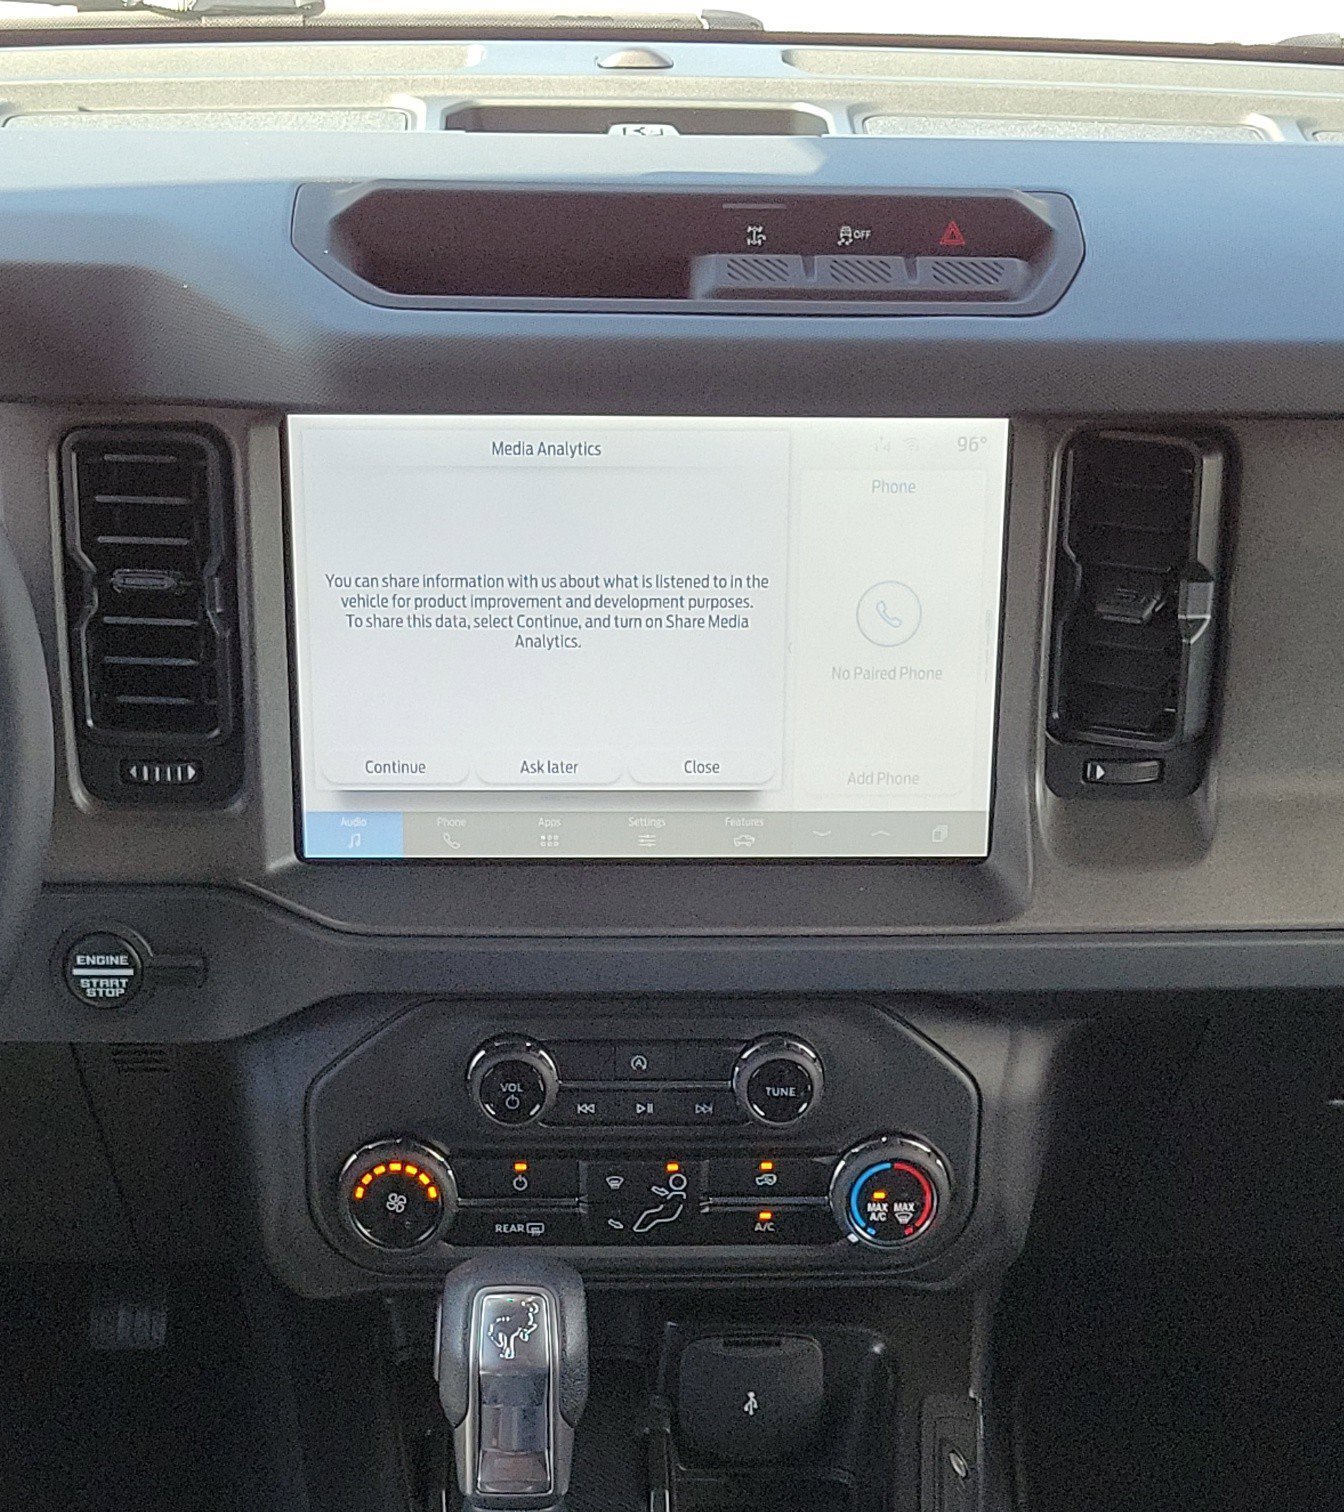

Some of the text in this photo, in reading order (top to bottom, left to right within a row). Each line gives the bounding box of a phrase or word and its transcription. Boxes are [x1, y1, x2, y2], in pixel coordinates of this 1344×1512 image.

[853, 228, 872, 240] OFF
[492, 441, 602, 459] Media Analytics
[871, 479, 917, 494] Phone
[325, 573, 770, 589] You can share information with us about what is listened to in the
[340, 593, 754, 611] vehicle for product improvement and development purposes.
[346, 613, 750, 631] To share this data, select Continue, and turn on Share Media
[515, 634, 582, 651] Analytics.
[831, 666, 943, 681] No Paired Phone
[365, 760, 427, 775] Continue
[520, 760, 579, 775] Ask later
[684, 760, 720, 775] Close
[847, 771, 920, 786] Add Phone
[340, 817, 367, 828] Audio
[436, 817, 467, 828] Phone
[537, 817, 562, 829] Apps
[628, 817, 666, 829] Settings
[725, 817, 764, 828] Features
[76, 955, 129, 966] ENGINE
[80, 978, 129, 988] START
[86, 988, 125, 997] STOP
[499, 1083, 524, 1094] VOL
[765, 1086, 797, 1098] TUNE
[867, 1202, 889, 1212] MAX
[893, 1202, 915, 1212] MAX
[869, 1212, 887, 1221] A/C
[494, 1222, 525, 1234] REAR
[754, 1221, 775, 1233] A/C
